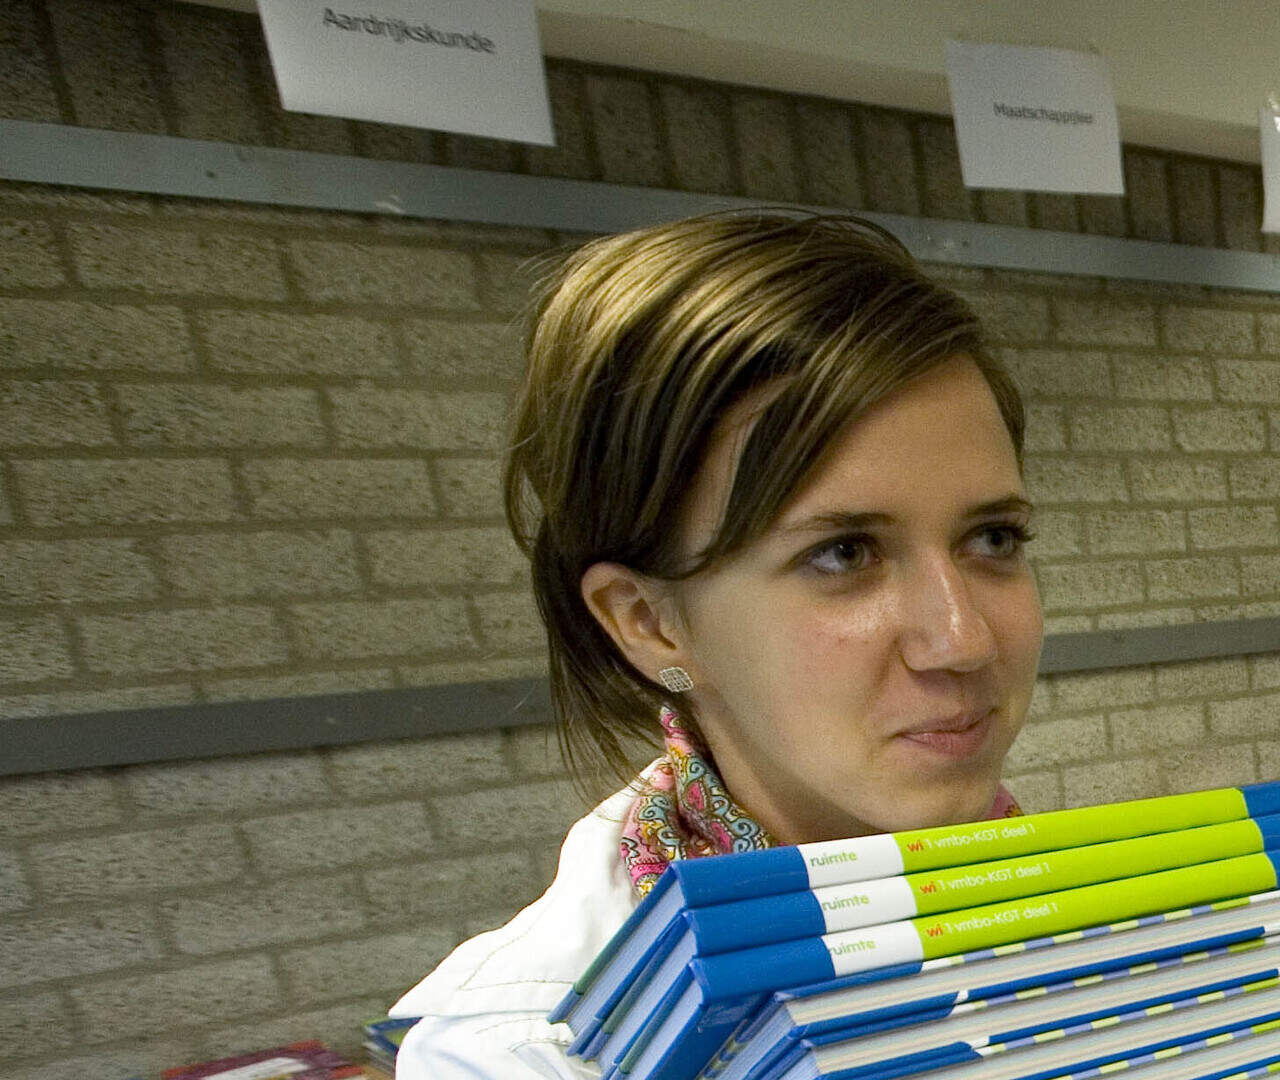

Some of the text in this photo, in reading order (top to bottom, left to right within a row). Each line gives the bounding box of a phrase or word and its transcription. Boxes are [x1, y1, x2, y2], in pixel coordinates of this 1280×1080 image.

[322, 7, 496, 55] Aardrijkskunde
[810, 823, 1036, 867] ruimte wi 1 vmbo-KGT deel 1
[822, 862, 1051, 911] ruimte wi 1 vmbo-KGT deel 1
[926, 924, 944, 938] wi
[945, 921, 953, 934] 1
[953, 908, 1021, 933] vmbo-KGT
[1023, 903, 1051, 919] deel
[1051, 902, 1059, 914] 1
